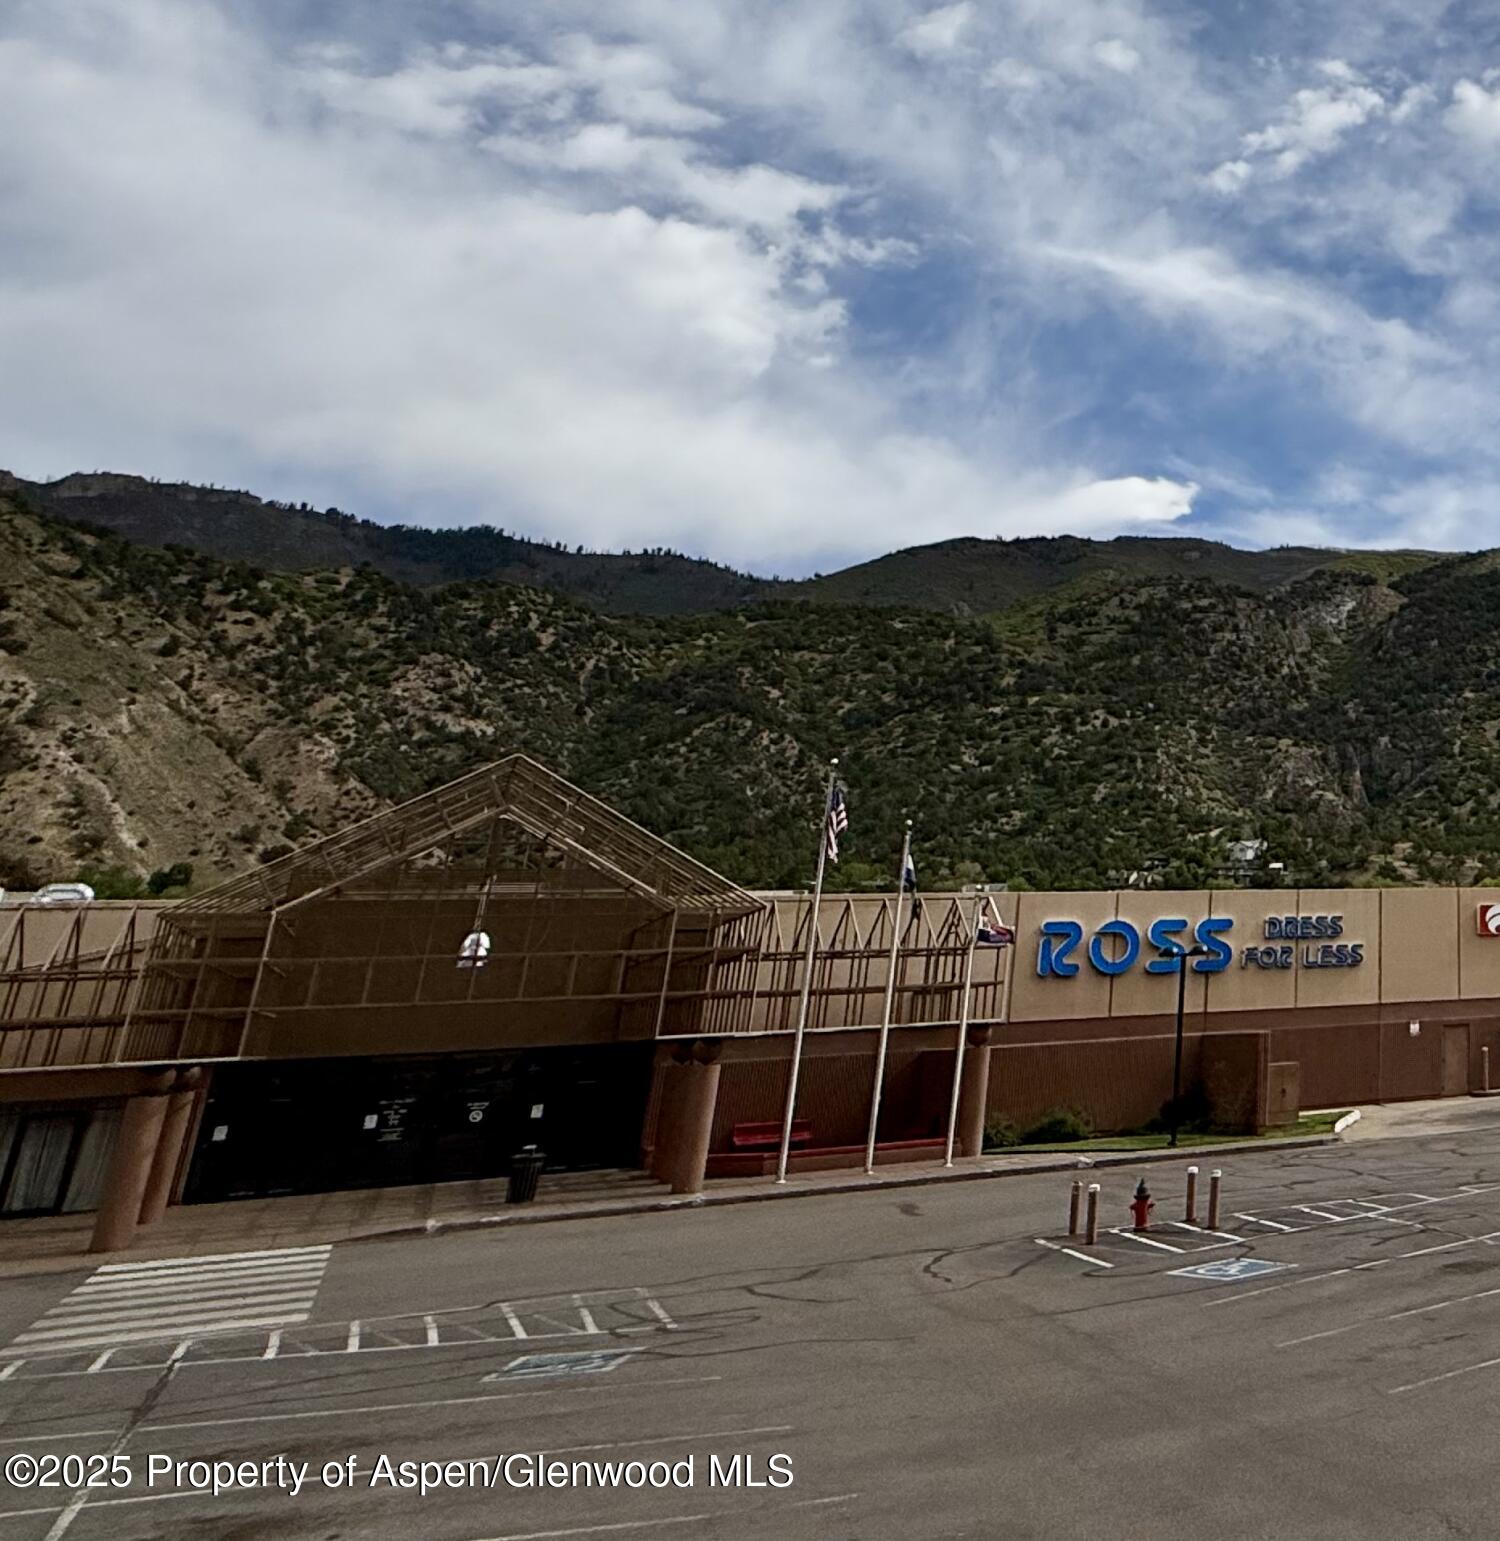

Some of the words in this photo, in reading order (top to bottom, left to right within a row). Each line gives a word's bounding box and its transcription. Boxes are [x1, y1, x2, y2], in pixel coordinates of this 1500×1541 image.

[1264, 915, 1344, 940] DRESS
[1036, 918, 1235, 977] ROSS
[1241, 946, 1294, 969] FOR
[1303, 944, 1364, 968] LESS
